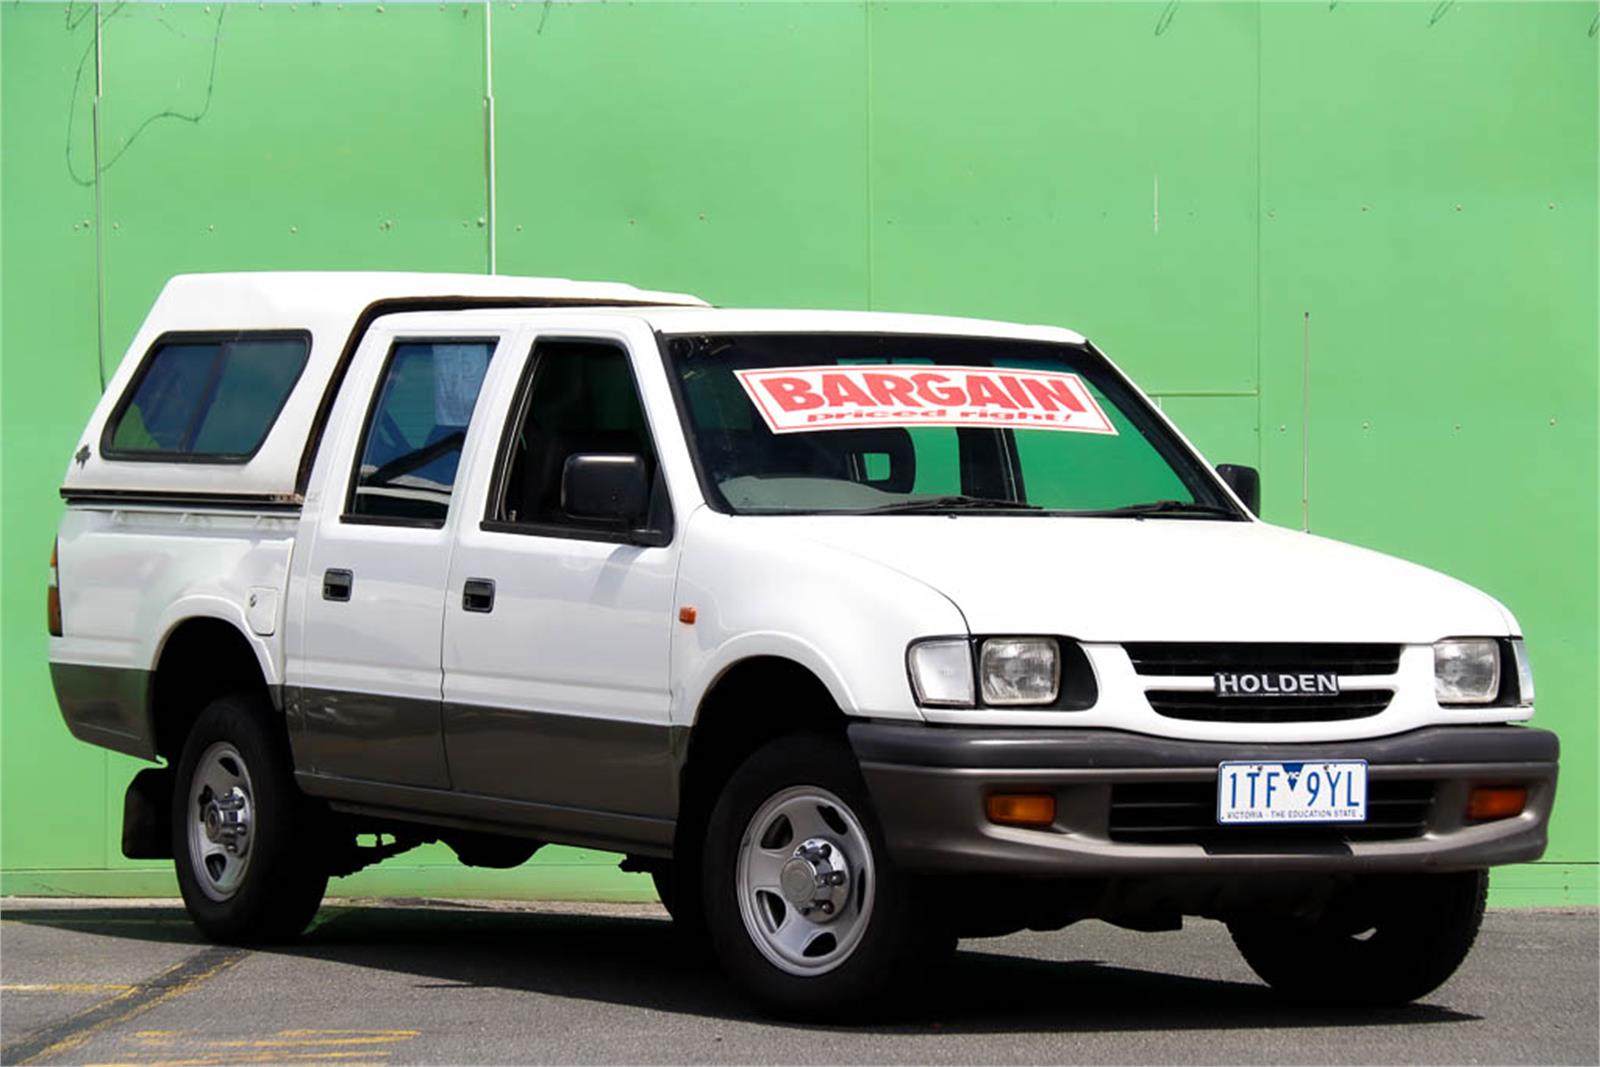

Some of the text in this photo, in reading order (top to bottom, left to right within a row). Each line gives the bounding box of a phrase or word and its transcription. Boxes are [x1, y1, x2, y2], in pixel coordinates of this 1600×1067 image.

[759, 373, 1088, 412] BARGAIN
[807, 409, 1072, 423] priced right!
[1219, 674, 1338, 693] HOLDEN
[1227, 811, 1263, 819] VICTORIA
[1271, 810, 1286, 818] THE
[1288, 809, 1332, 819] EDUCATION
[1334, 809, 1356, 818] STATE
